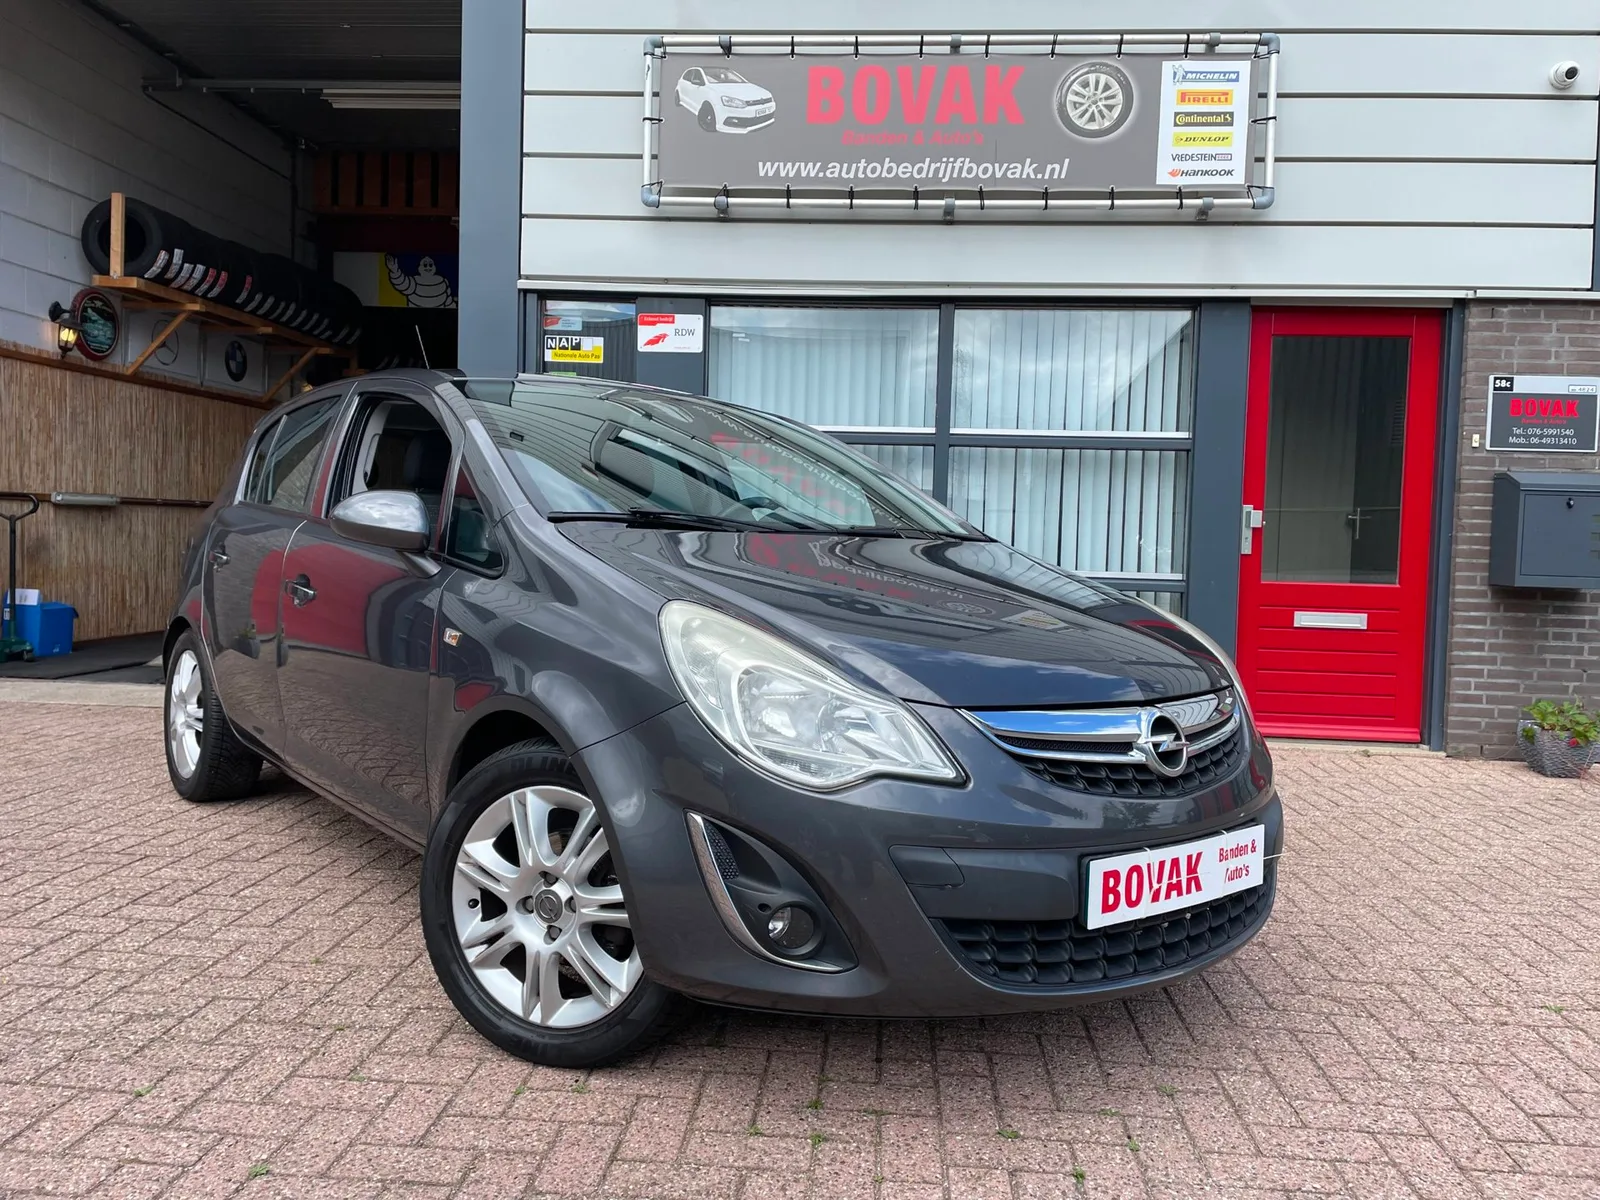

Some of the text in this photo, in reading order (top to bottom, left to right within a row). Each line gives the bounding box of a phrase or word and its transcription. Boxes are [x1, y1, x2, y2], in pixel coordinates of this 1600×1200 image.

[806, 64, 1025, 125] BOVAK
[1180, 92, 1229, 103] PIRELLI
[1176, 114, 1224, 125] Continental
[841, 130, 984, 146] Banden & Auto's
[1171, 153, 1216, 161] VREDESTEIN
[758, 157, 1069, 182] www.autobedrijfbovak.nl
[674, 328, 696, 336] RDW
[547, 337, 580, 348] NAP
[1494, 379, 1511, 387] 58c
[1509, 398, 1580, 417] BOVAK
[1512, 427, 1574, 436] Tel.: 076-5991540
[1508, 436, 1577, 445] Mob.: 06-49313410
[1218, 839, 1257, 863] Banden &
[1101, 851, 1204, 914] BOVAK
